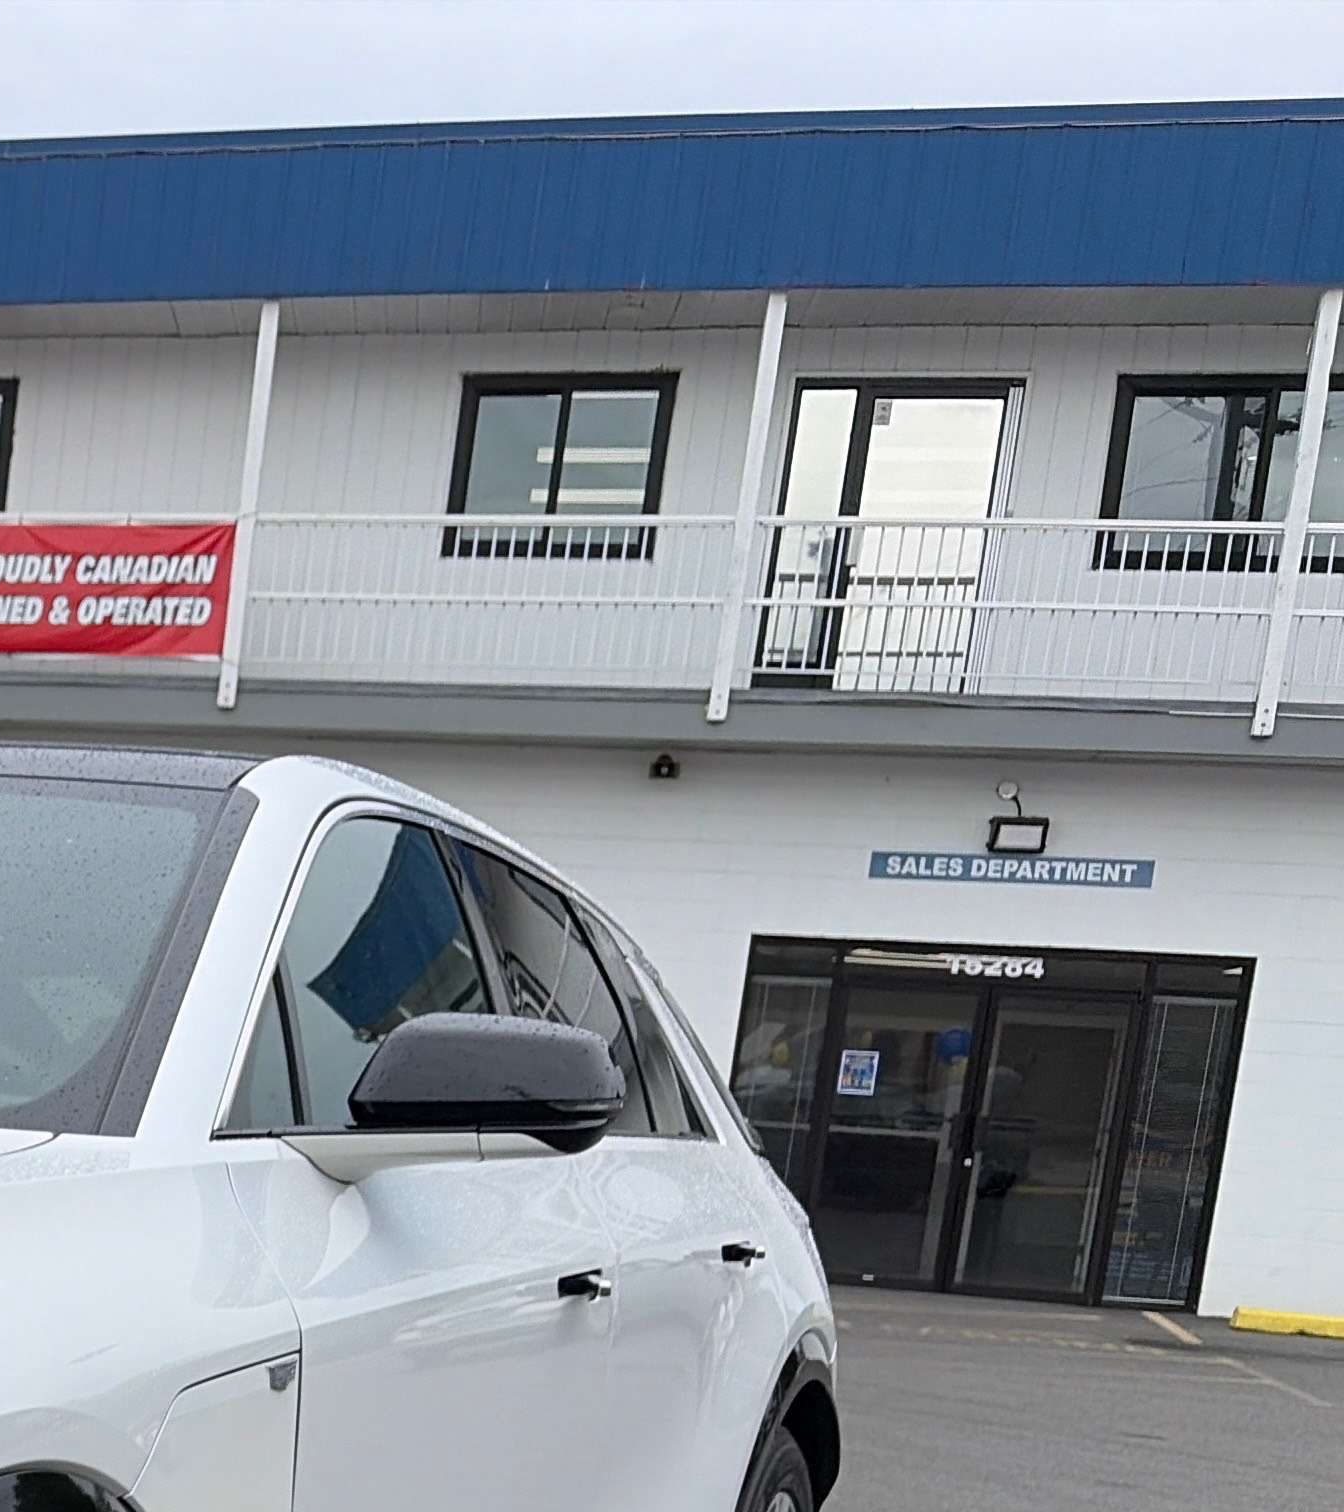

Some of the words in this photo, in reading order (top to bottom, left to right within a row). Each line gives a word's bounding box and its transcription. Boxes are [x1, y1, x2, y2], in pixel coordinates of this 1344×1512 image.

[75, 554, 219, 586] CANADIAN
[47, 597, 72, 625] &
[76, 596, 212, 627] OPERATED
[885, 856, 964, 877] SALES
[969, 858, 1139, 883] DEPARTMENT
